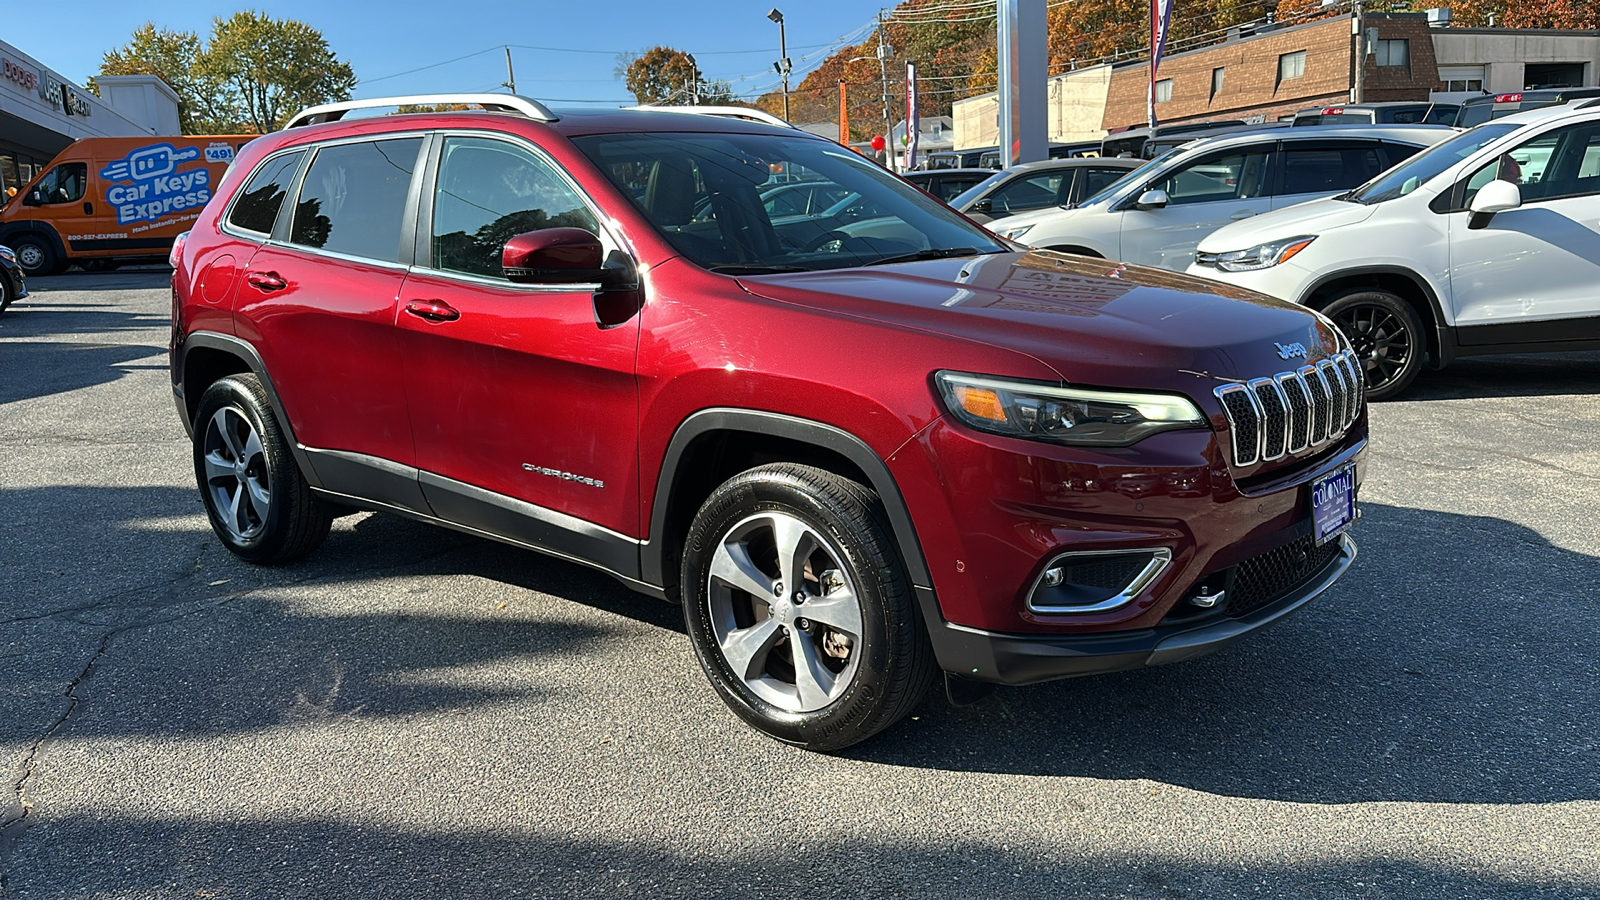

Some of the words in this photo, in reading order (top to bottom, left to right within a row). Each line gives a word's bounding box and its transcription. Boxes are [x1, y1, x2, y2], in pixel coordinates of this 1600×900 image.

[3, 58, 38, 90] DODGE
[43, 72, 63, 106] Jeep
[75, 97, 91, 116] RAM
[206, 149, 232, 159] $49!
[109, 183, 149, 205] Car
[154, 171, 207, 195] Keys
[120, 189, 209, 223] Express
[132, 225, 149, 234] Made
[1273, 342, 1307, 360] Jeep
[521, 462, 604, 488] CHEROKEE
[1313, 474, 1352, 508] COLONIAL
[692, 493, 735, 552] Continental
[821, 684, 874, 739] Continental
